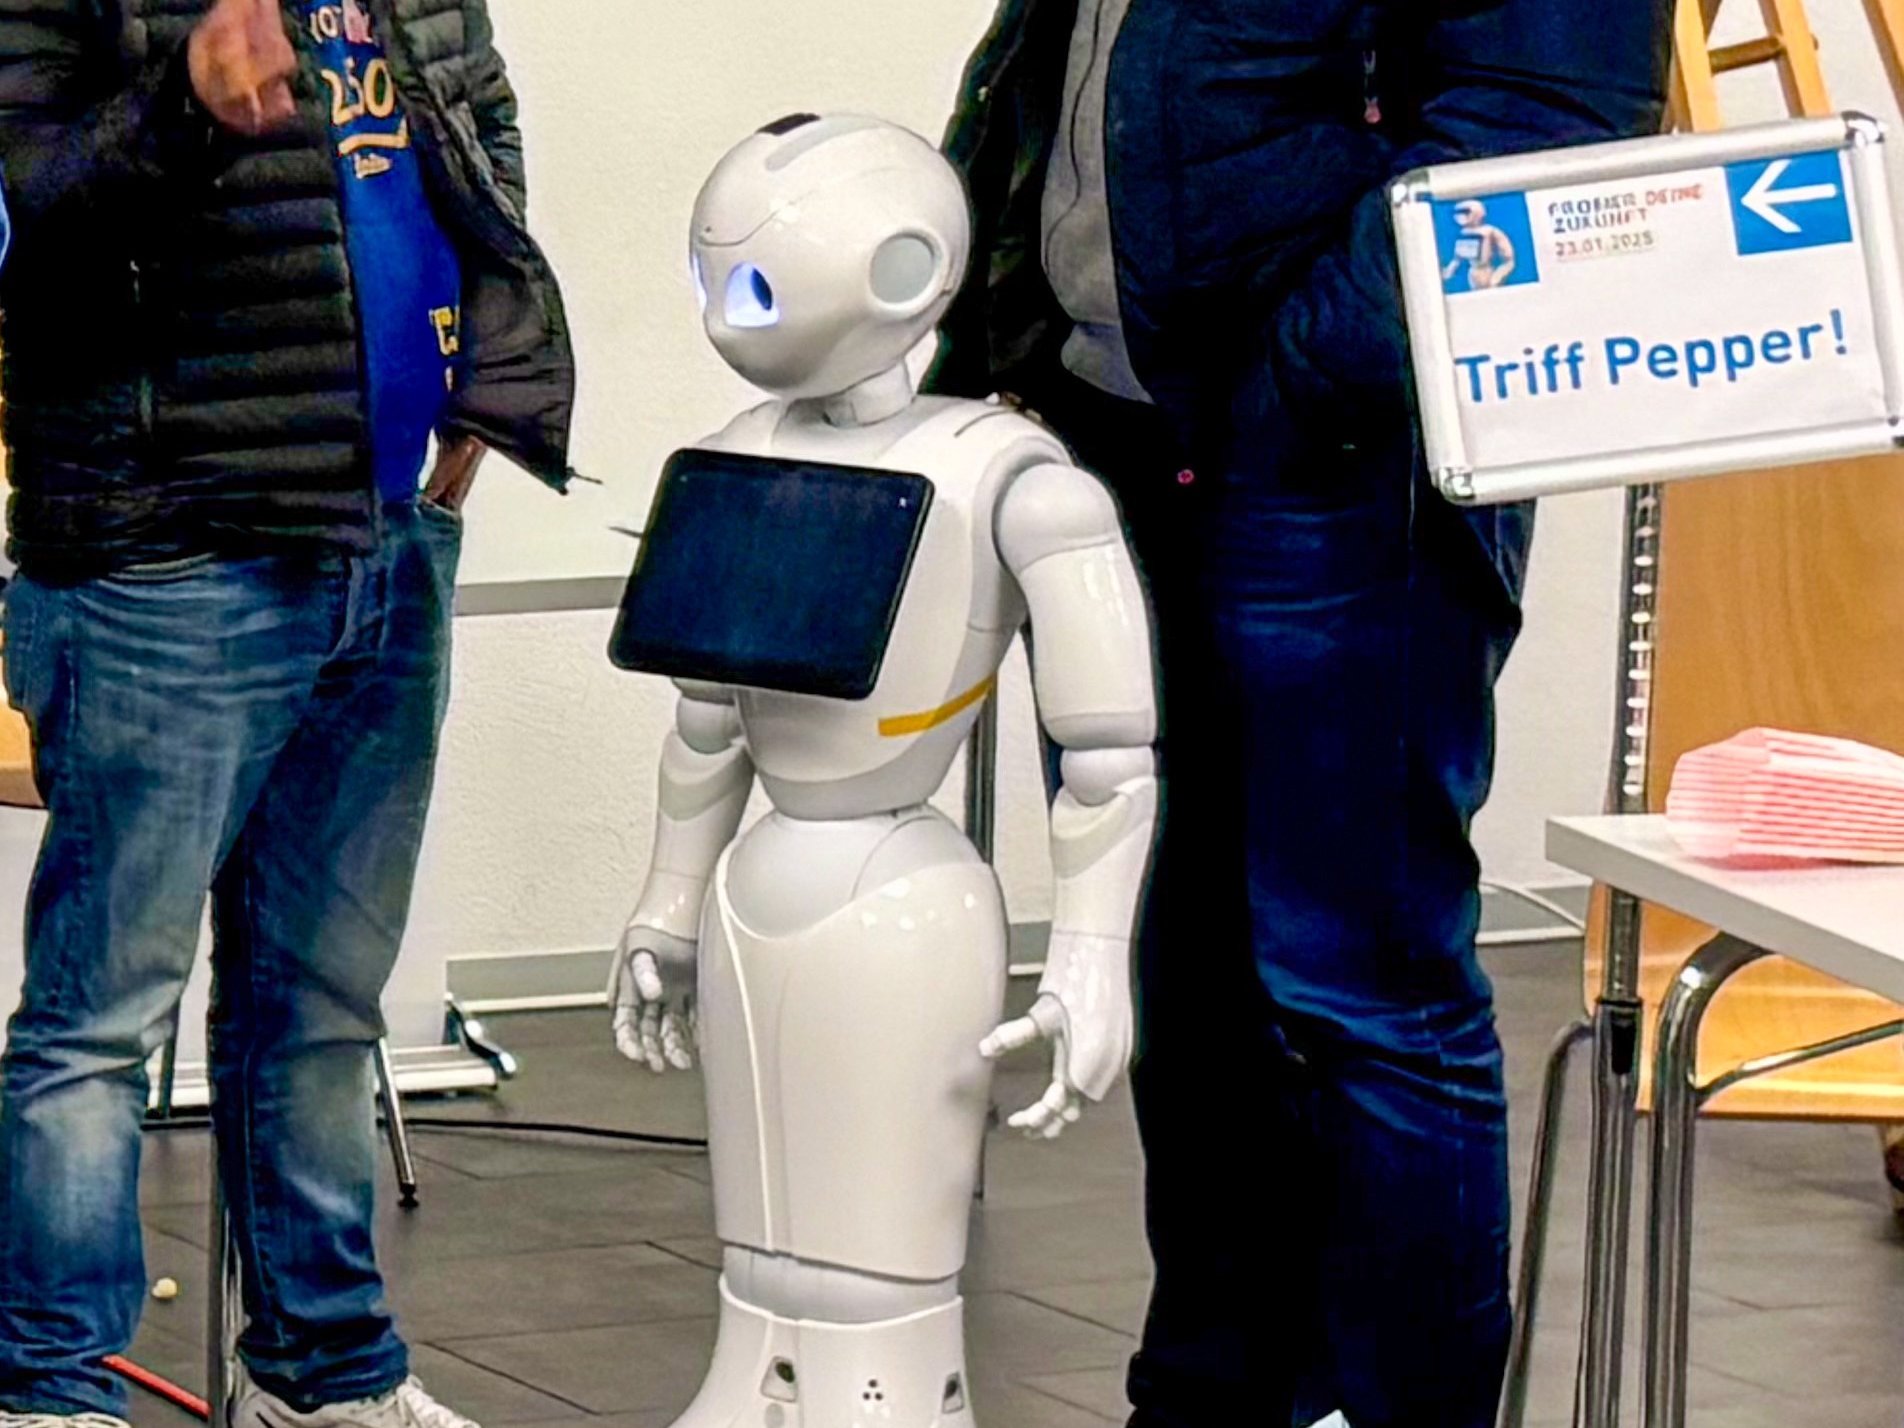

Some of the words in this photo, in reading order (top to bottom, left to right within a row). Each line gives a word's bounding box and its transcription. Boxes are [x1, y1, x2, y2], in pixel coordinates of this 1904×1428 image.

[1548, 192, 1637, 217] PROBIER
[1645, 183, 1705, 207] DEINE
[1553, 207, 1647, 234] ZUKUNFT
[1453, 340, 1585, 404] Triff
[1604, 308, 1848, 388] Pepper!
